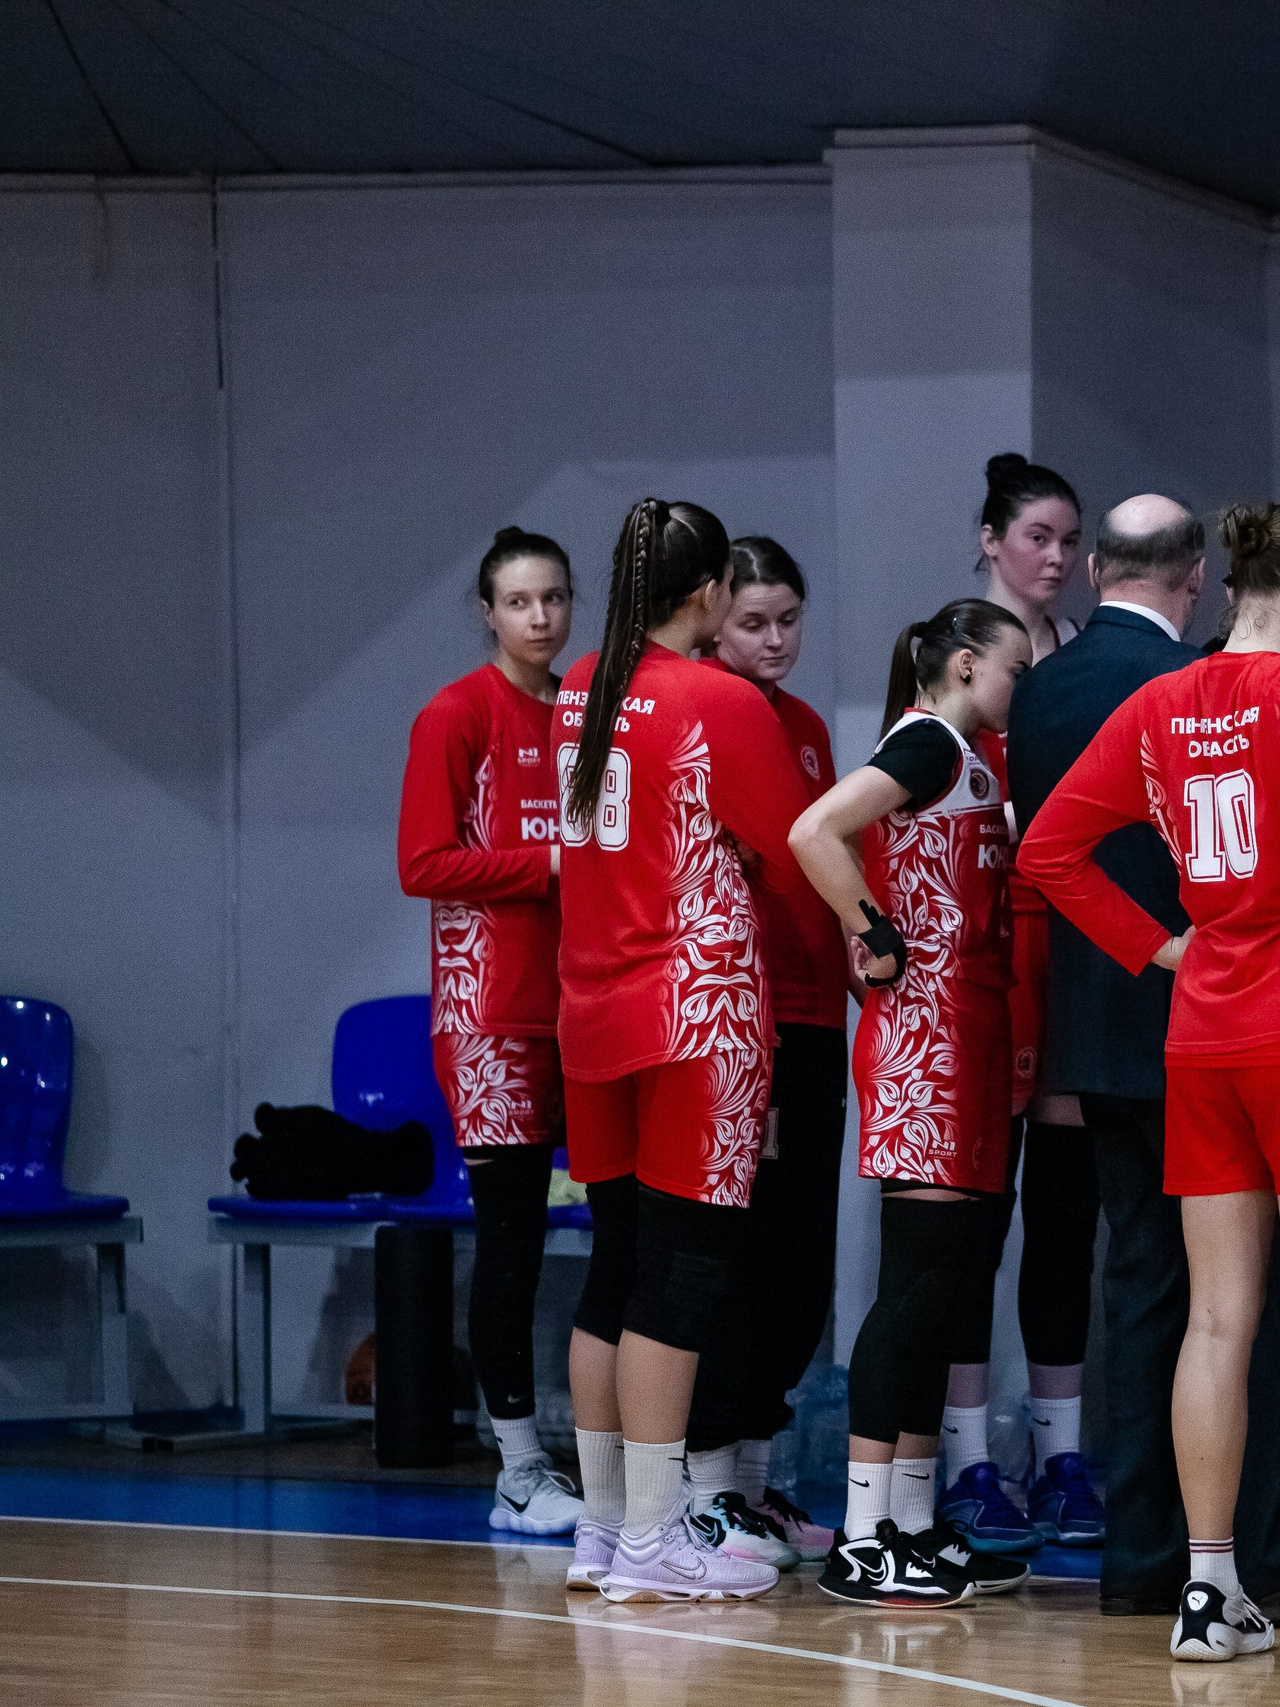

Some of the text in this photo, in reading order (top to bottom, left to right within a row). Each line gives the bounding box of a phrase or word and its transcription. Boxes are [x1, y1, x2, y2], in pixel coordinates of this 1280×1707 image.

[556, 690, 656, 715] ПЕНЗКАЯ
[562, 710, 631, 733] ОБТЬ
[1170, 706, 1260, 735] ПЕННСКАЯ
[1188, 733, 1250, 758] ОБАСТЬ
[1183, 768, 1259, 883] 10
[928, 1148, 957, 1157] SPORT
